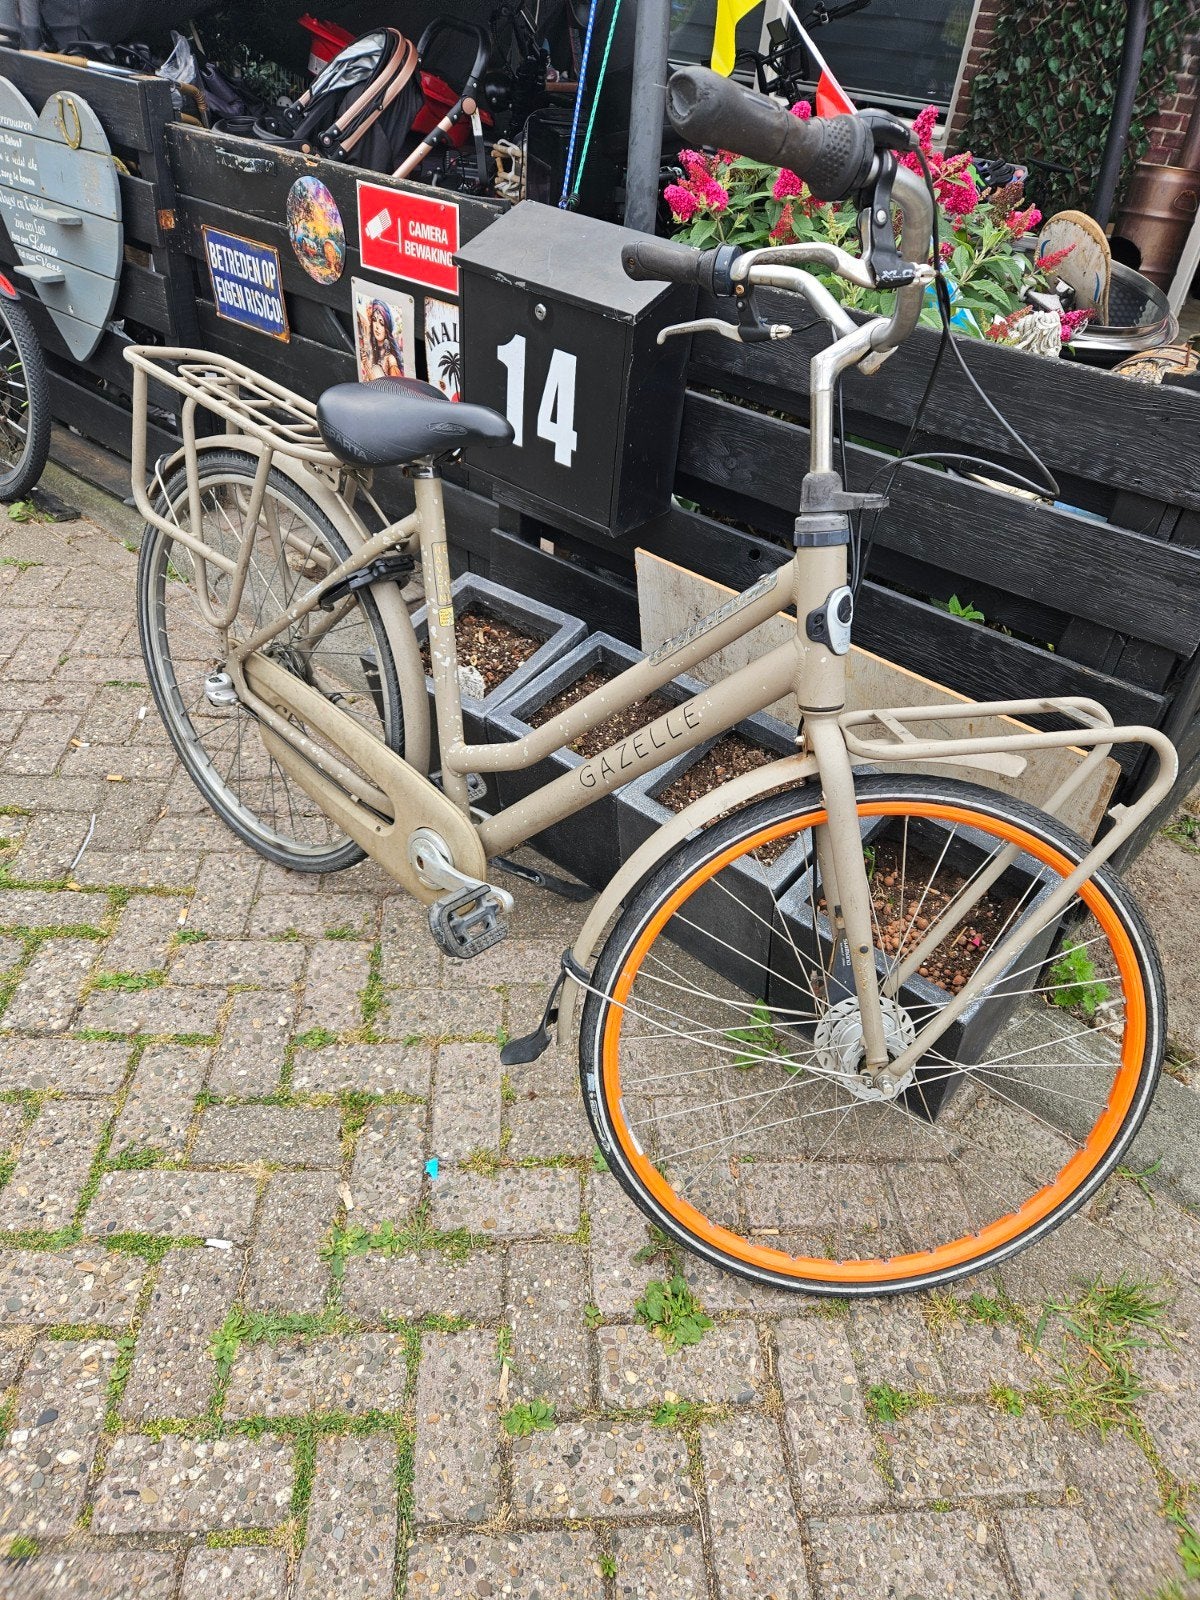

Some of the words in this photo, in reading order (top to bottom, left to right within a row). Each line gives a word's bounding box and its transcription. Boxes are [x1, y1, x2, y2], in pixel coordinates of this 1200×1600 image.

[404, 239, 454, 267] BEWAKING
[408, 220, 448, 245] CAMERA
[208, 241, 262, 285] BETREDEN
[261, 259, 276, 290] OP
[214, 275, 246, 310] EIGEN
[243, 286, 284, 325] RISICO!
[497, 333, 578, 468] 14
[323, 423, 369, 461] SPARTA
[578, 701, 701, 788] GAZELLE
[842, 938, 852, 966] SHIMANO
